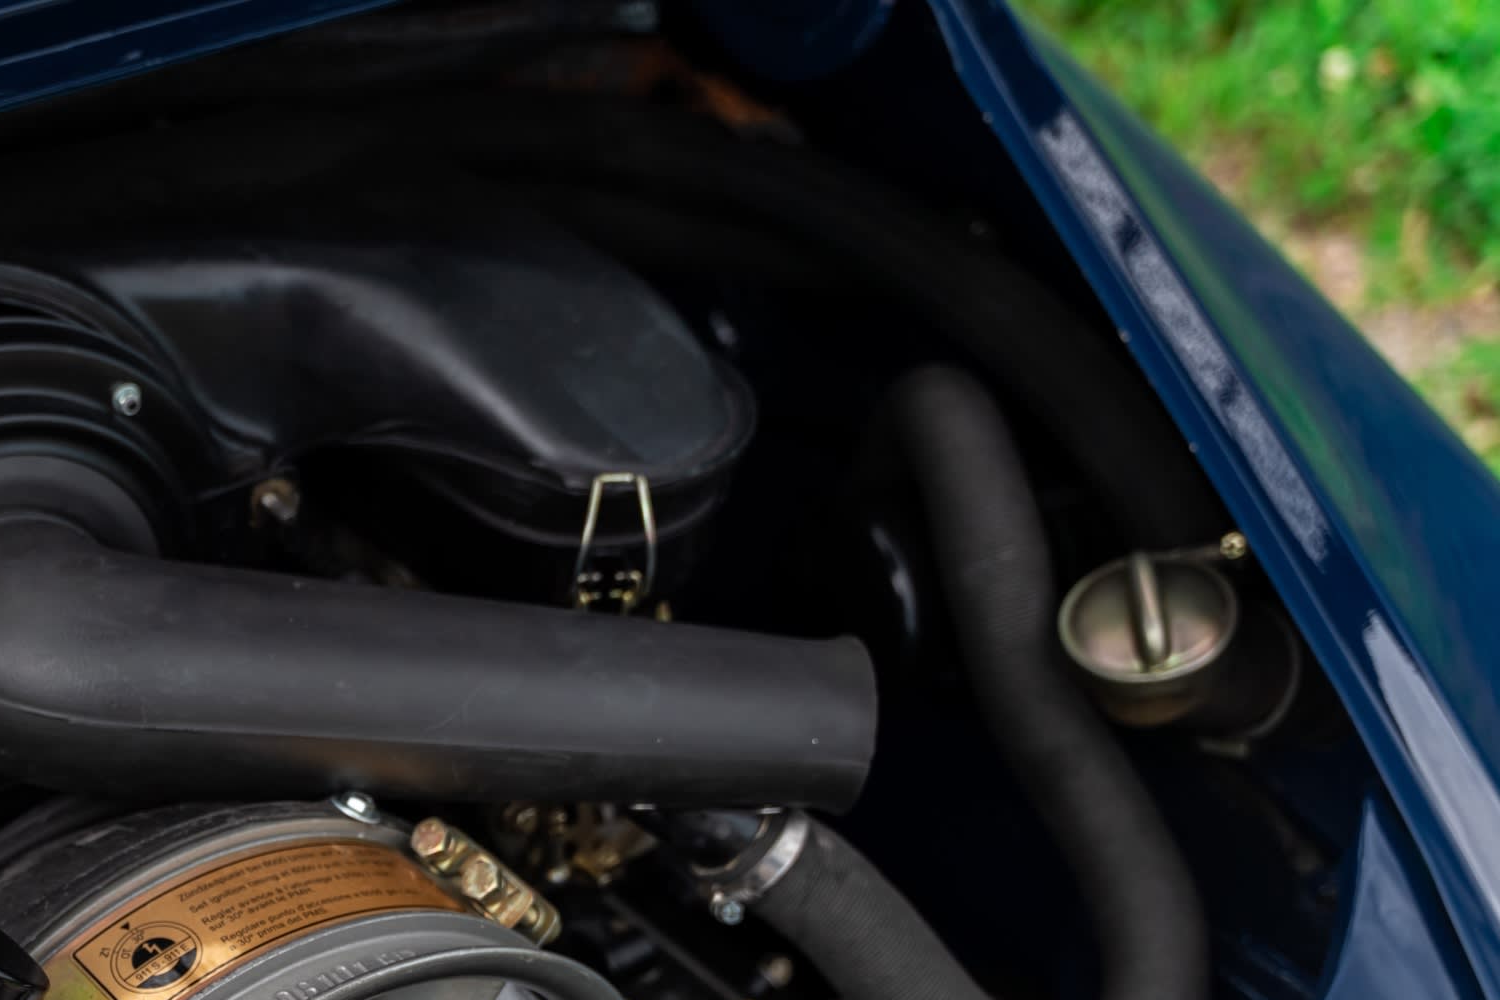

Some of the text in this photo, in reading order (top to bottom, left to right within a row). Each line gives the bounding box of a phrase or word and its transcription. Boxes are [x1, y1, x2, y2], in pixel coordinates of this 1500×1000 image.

[257, 923, 285, 938] prima
[135, 968, 153, 981] 911
[151, 961, 161, 971] S
[163, 948, 181, 962] 911
[180, 942, 189, 951] E
